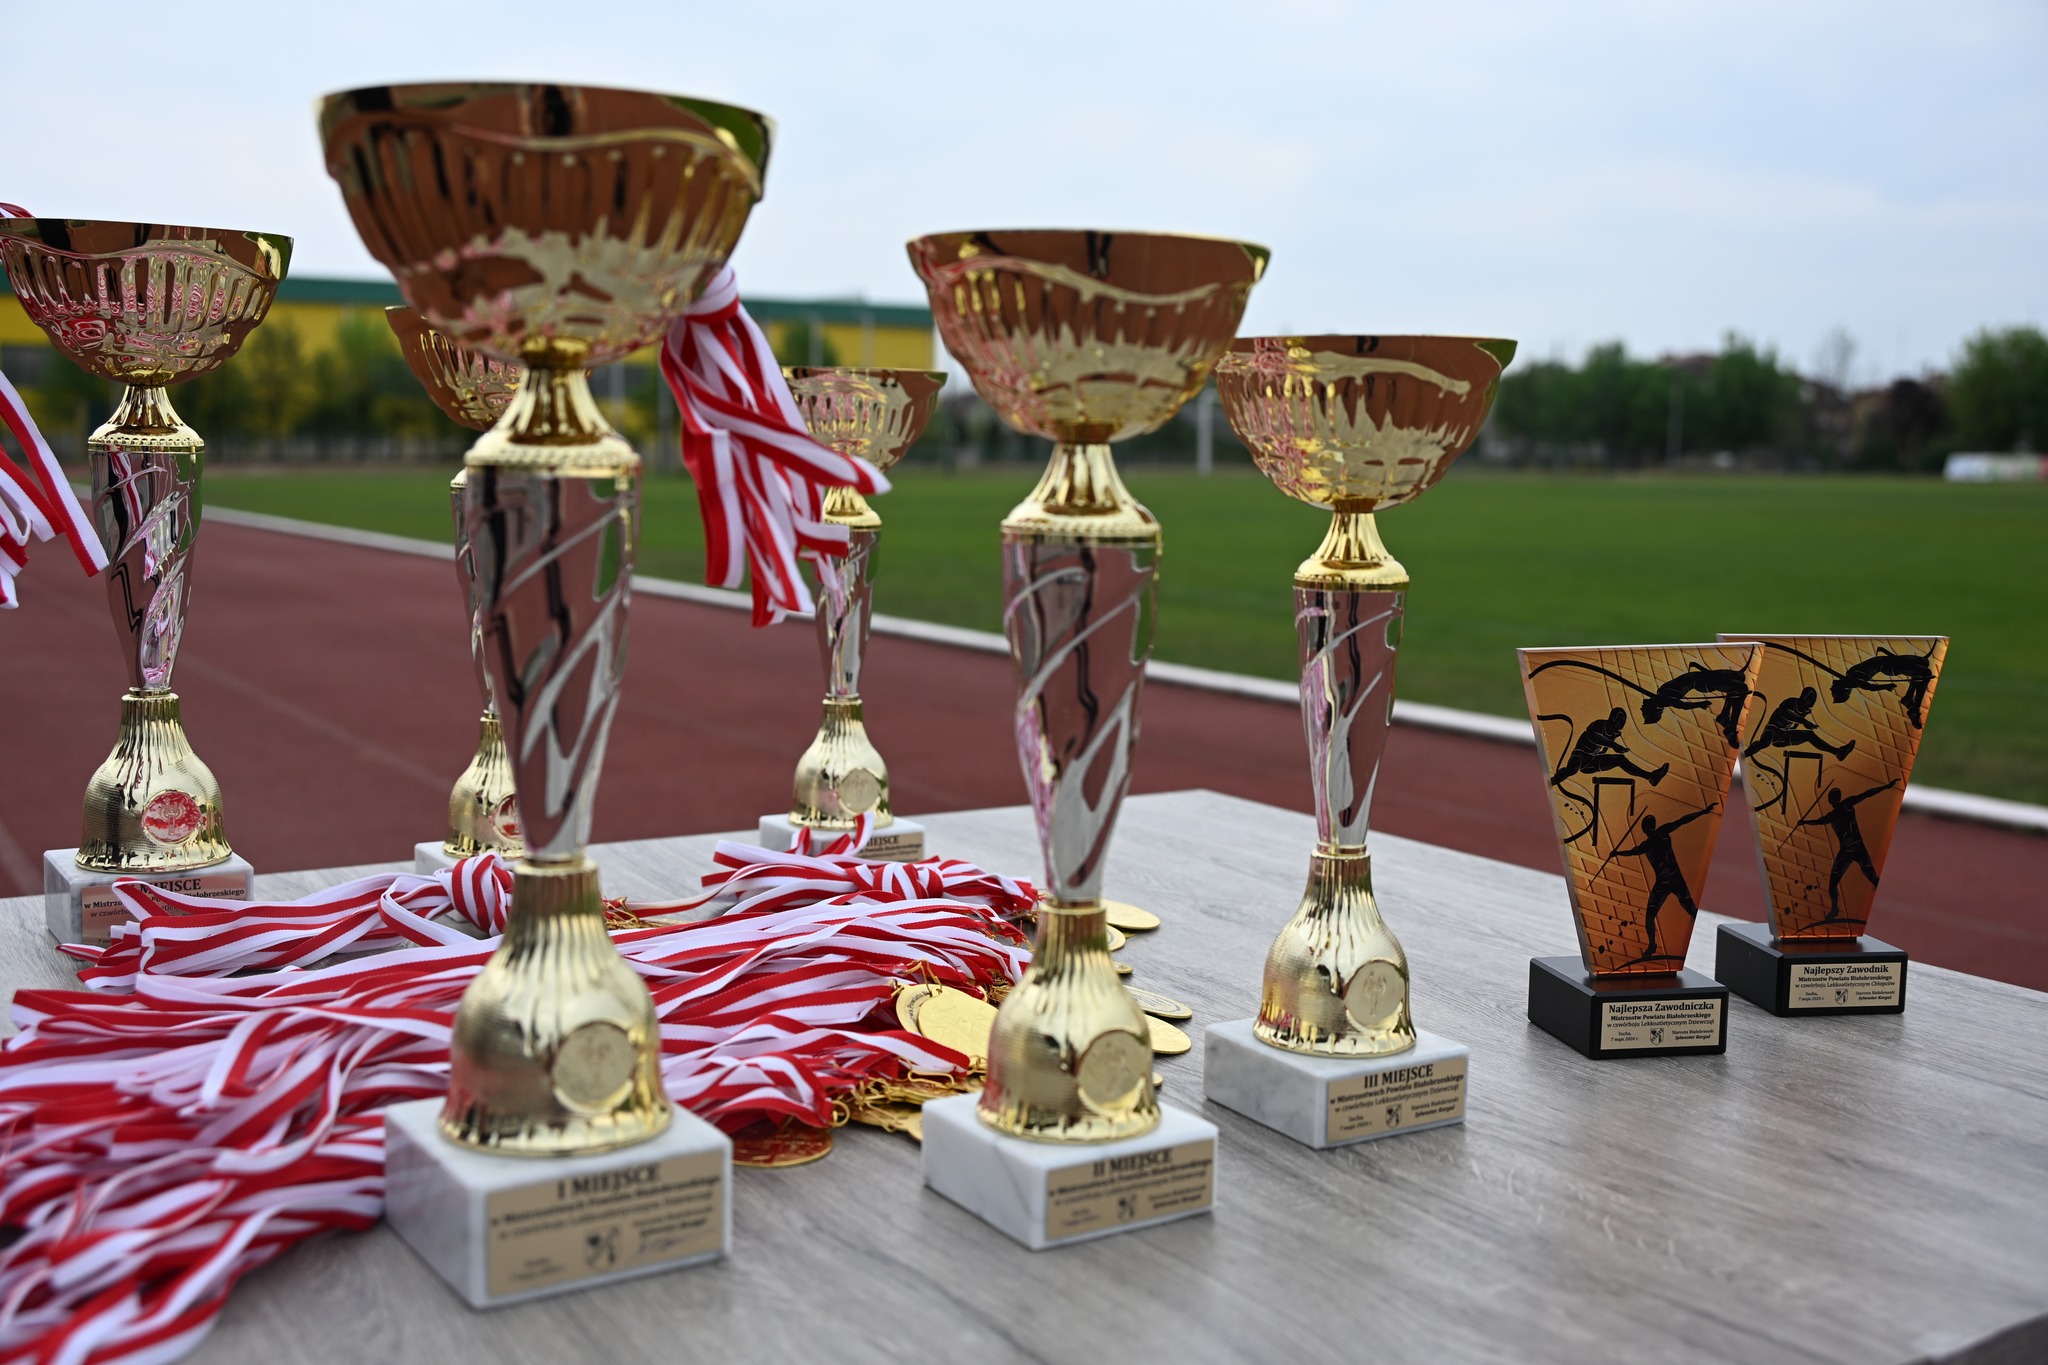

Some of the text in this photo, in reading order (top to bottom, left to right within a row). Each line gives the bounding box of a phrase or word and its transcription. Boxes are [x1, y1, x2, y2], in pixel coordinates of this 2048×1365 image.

[93, 900, 122, 908] Mistrzo
[98, 908, 132, 917] czwórbo
[1804, 965, 1889, 975] Najlepszy Zawodnik
[1609, 1002, 1714, 1014] Najlepsza Zawodniczka
[1364, 1064, 1434, 1089] III MIEJSCE
[1337, 1089, 1385, 1103] Mistrzostwach
[1386, 1084, 1412, 1093] Powiatu
[1413, 1074, 1464, 1089] Białobrzeskiego
[1093, 1149, 1172, 1177] II MIEJSCE
[557, 1164, 661, 1200] I MIEJSCE
